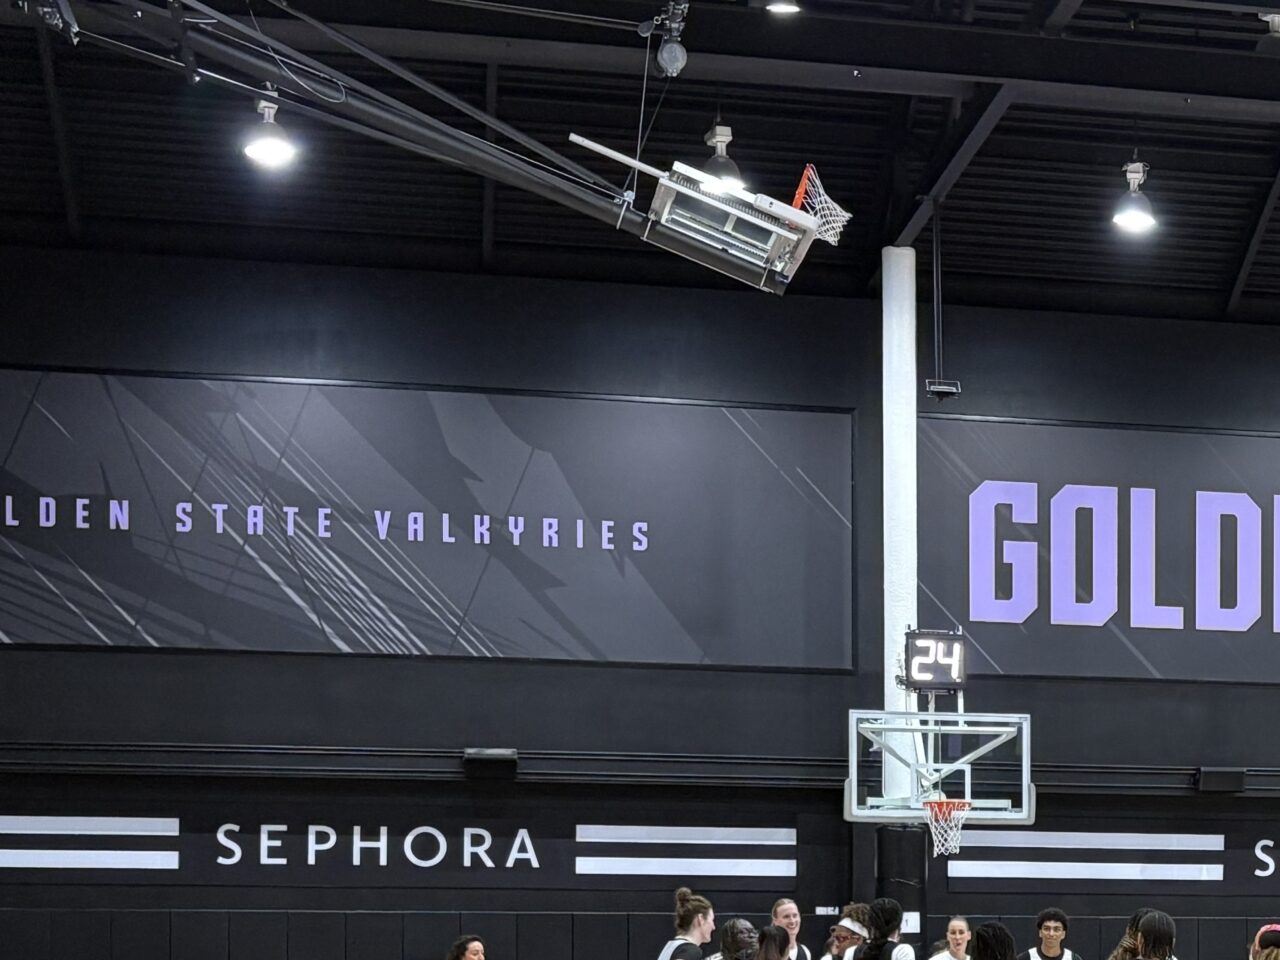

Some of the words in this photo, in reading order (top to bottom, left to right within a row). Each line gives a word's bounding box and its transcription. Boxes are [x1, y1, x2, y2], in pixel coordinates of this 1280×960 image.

[5, 495, 129, 529] LDEN
[175, 501, 332, 538] STATE
[373, 510, 650, 552] VALKYRIES
[911, 639, 960, 681] 24
[216, 823, 541, 868] SEPHORA
